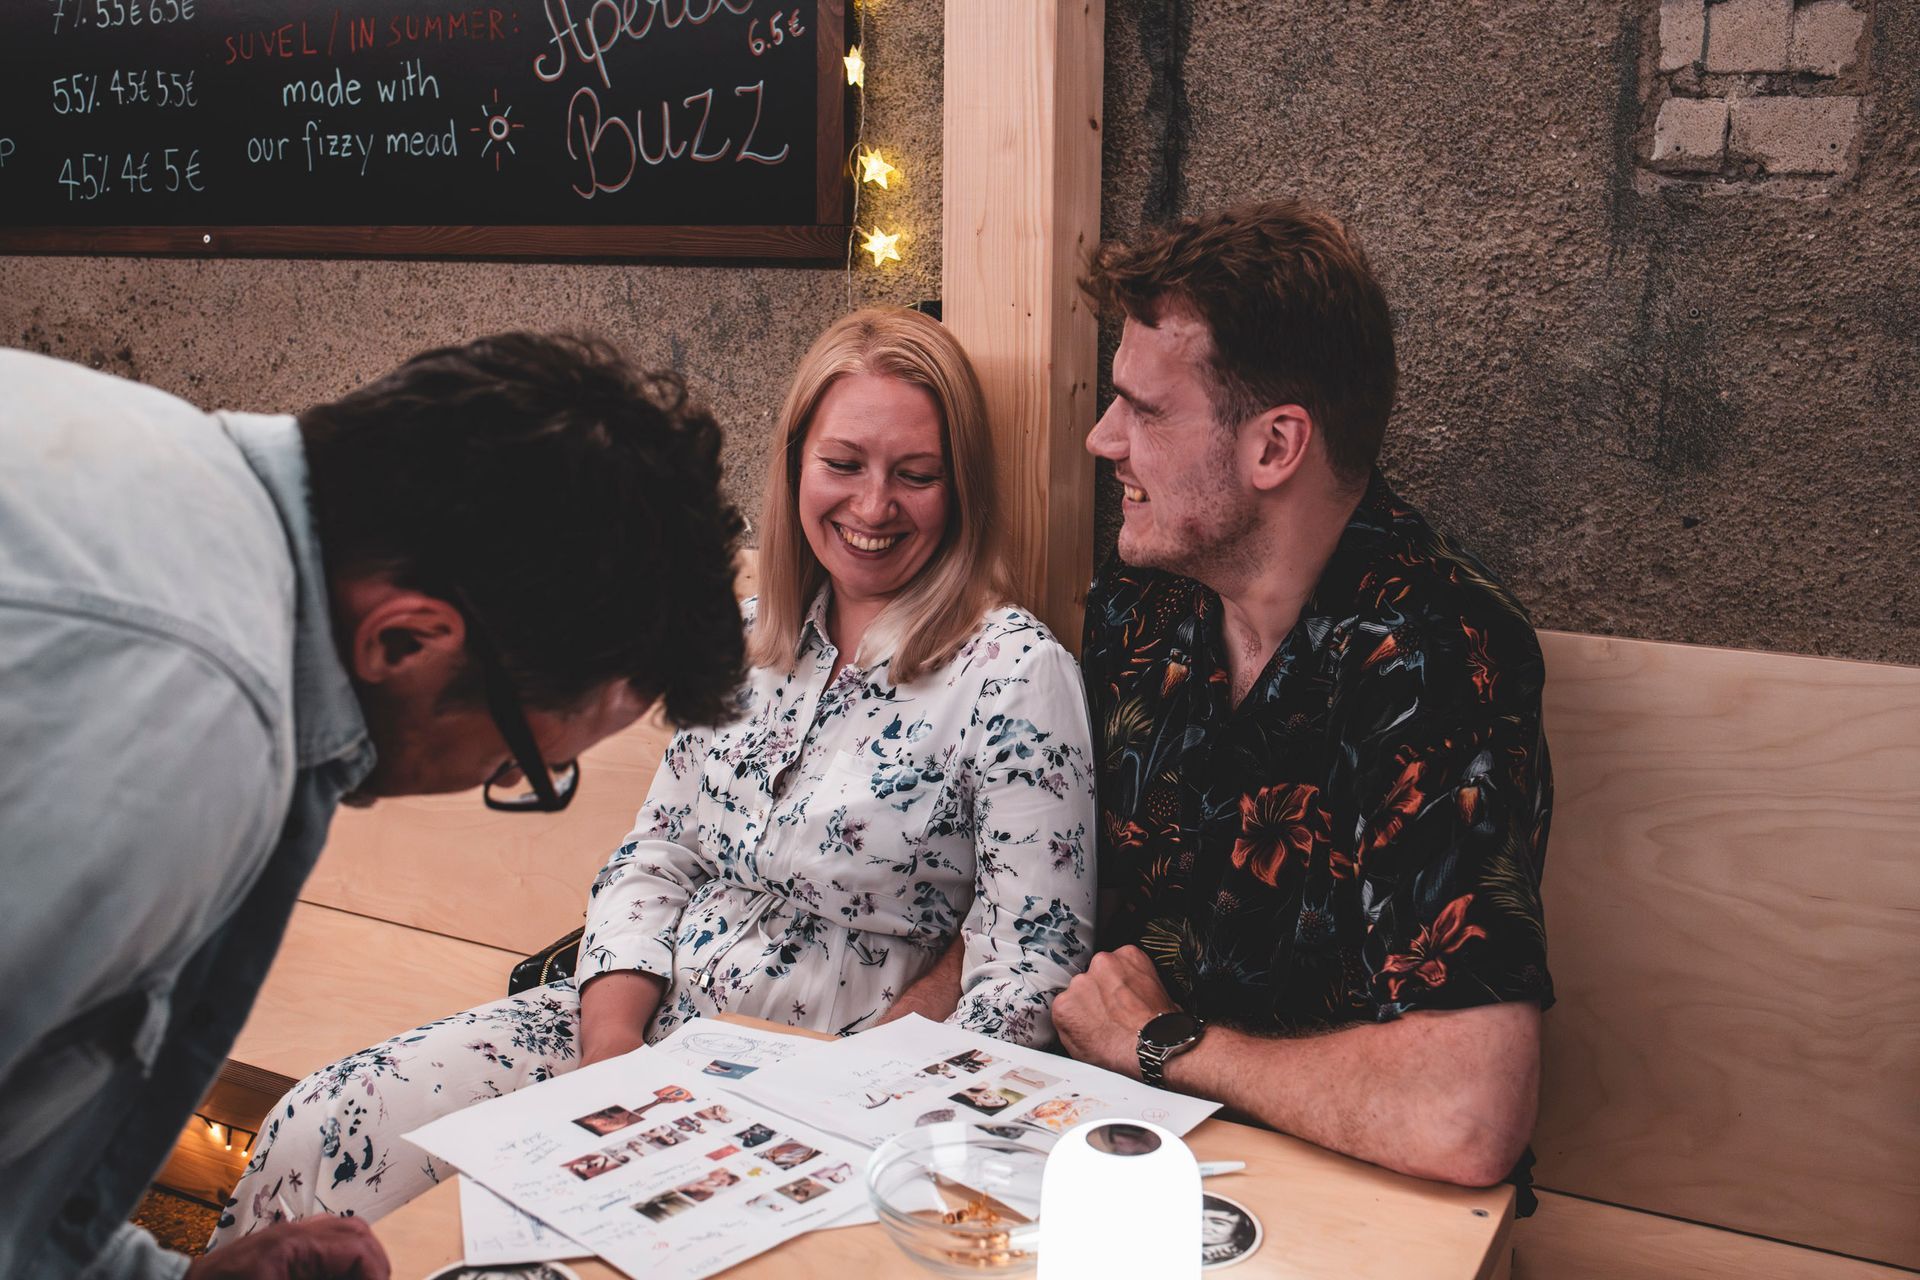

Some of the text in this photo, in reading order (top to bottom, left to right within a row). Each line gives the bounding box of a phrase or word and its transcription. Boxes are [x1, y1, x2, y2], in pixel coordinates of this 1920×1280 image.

[225, 23, 318, 65] SUVEL
[350, 17, 376, 54] IN
[386, 8, 520, 48] SUMMER:
[749, 9, 805, 56] 6.5€
[282, 58, 440, 107] made with
[247, 118, 458, 176] our fizzy mead
[121, 152, 152, 192] 4€
